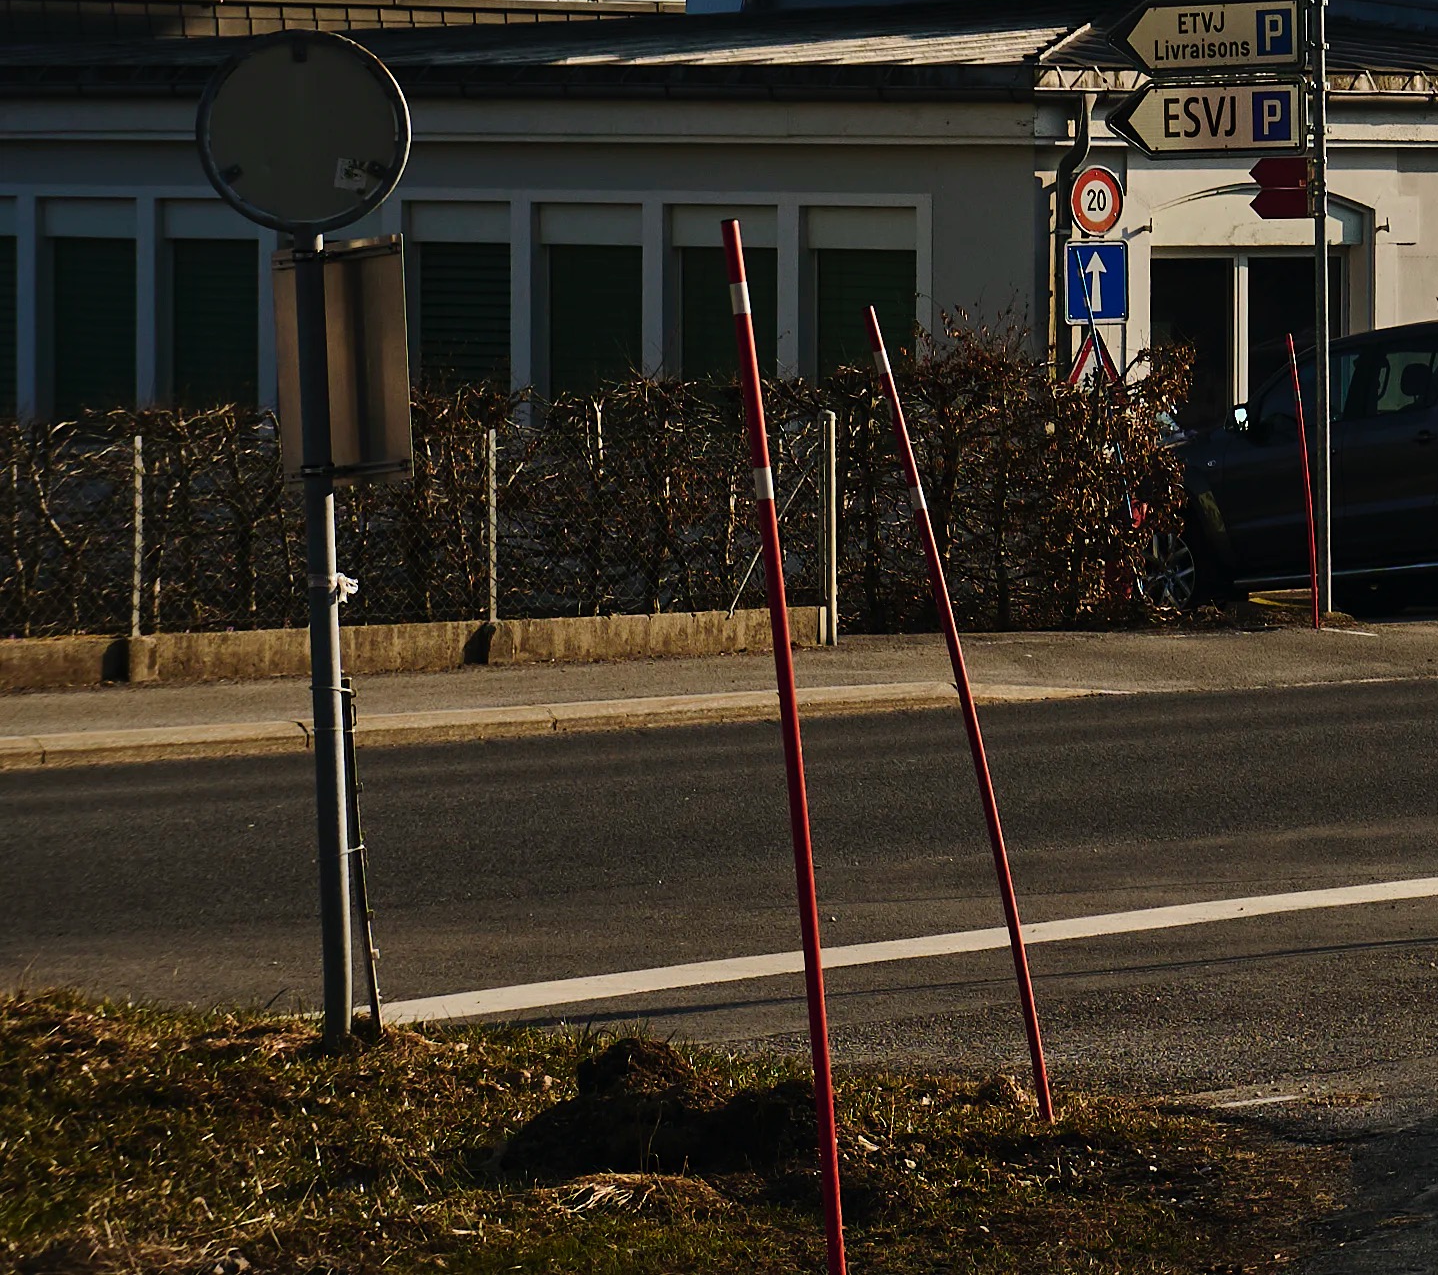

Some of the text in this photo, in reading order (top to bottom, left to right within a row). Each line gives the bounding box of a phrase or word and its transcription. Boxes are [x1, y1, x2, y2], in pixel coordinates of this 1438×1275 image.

[1177, 11, 1225, 35] ETVJ
[1264, 14, 1283, 51] P
[1154, 38, 1251, 61] Livraisons
[1163, 96, 1237, 138] ESVJ
[1262, 99, 1282, 135] P
[1086, 188, 1107, 212] 20
